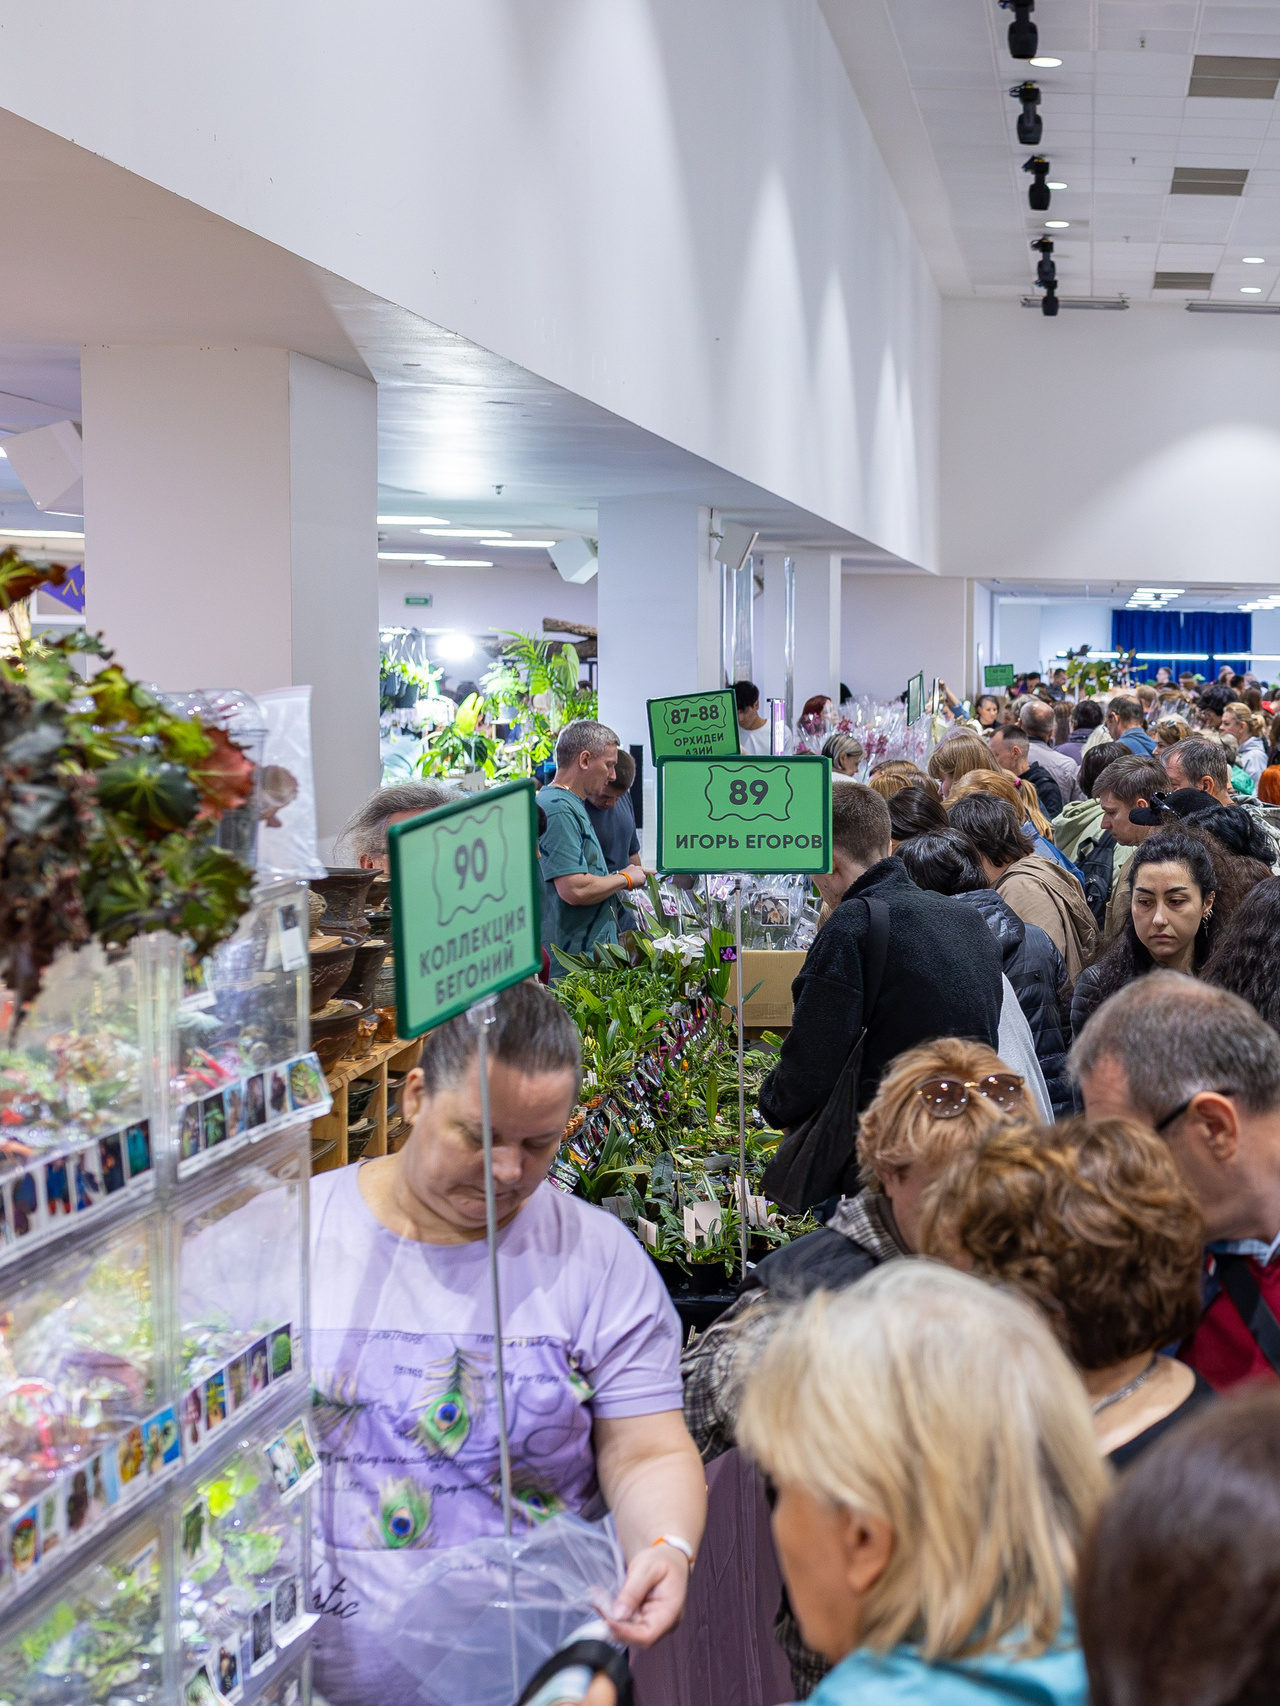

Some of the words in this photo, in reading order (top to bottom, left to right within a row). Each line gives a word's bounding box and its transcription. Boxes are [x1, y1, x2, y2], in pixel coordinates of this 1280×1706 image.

[670, 704, 720, 725] 87-88
[673, 732, 725, 748] ОРХИДЕИ
[685, 745, 713, 755] АЗИИ
[728, 779, 769, 806] 89
[675, 833, 740, 849] ИГОРЬ
[745, 833, 823, 849] ЕГОРОВ
[453, 837, 488, 891] 90
[418, 905, 527, 978] КОЛЛЕКЦИЯ
[434, 940, 515, 1006] БЕГОНИЙ
